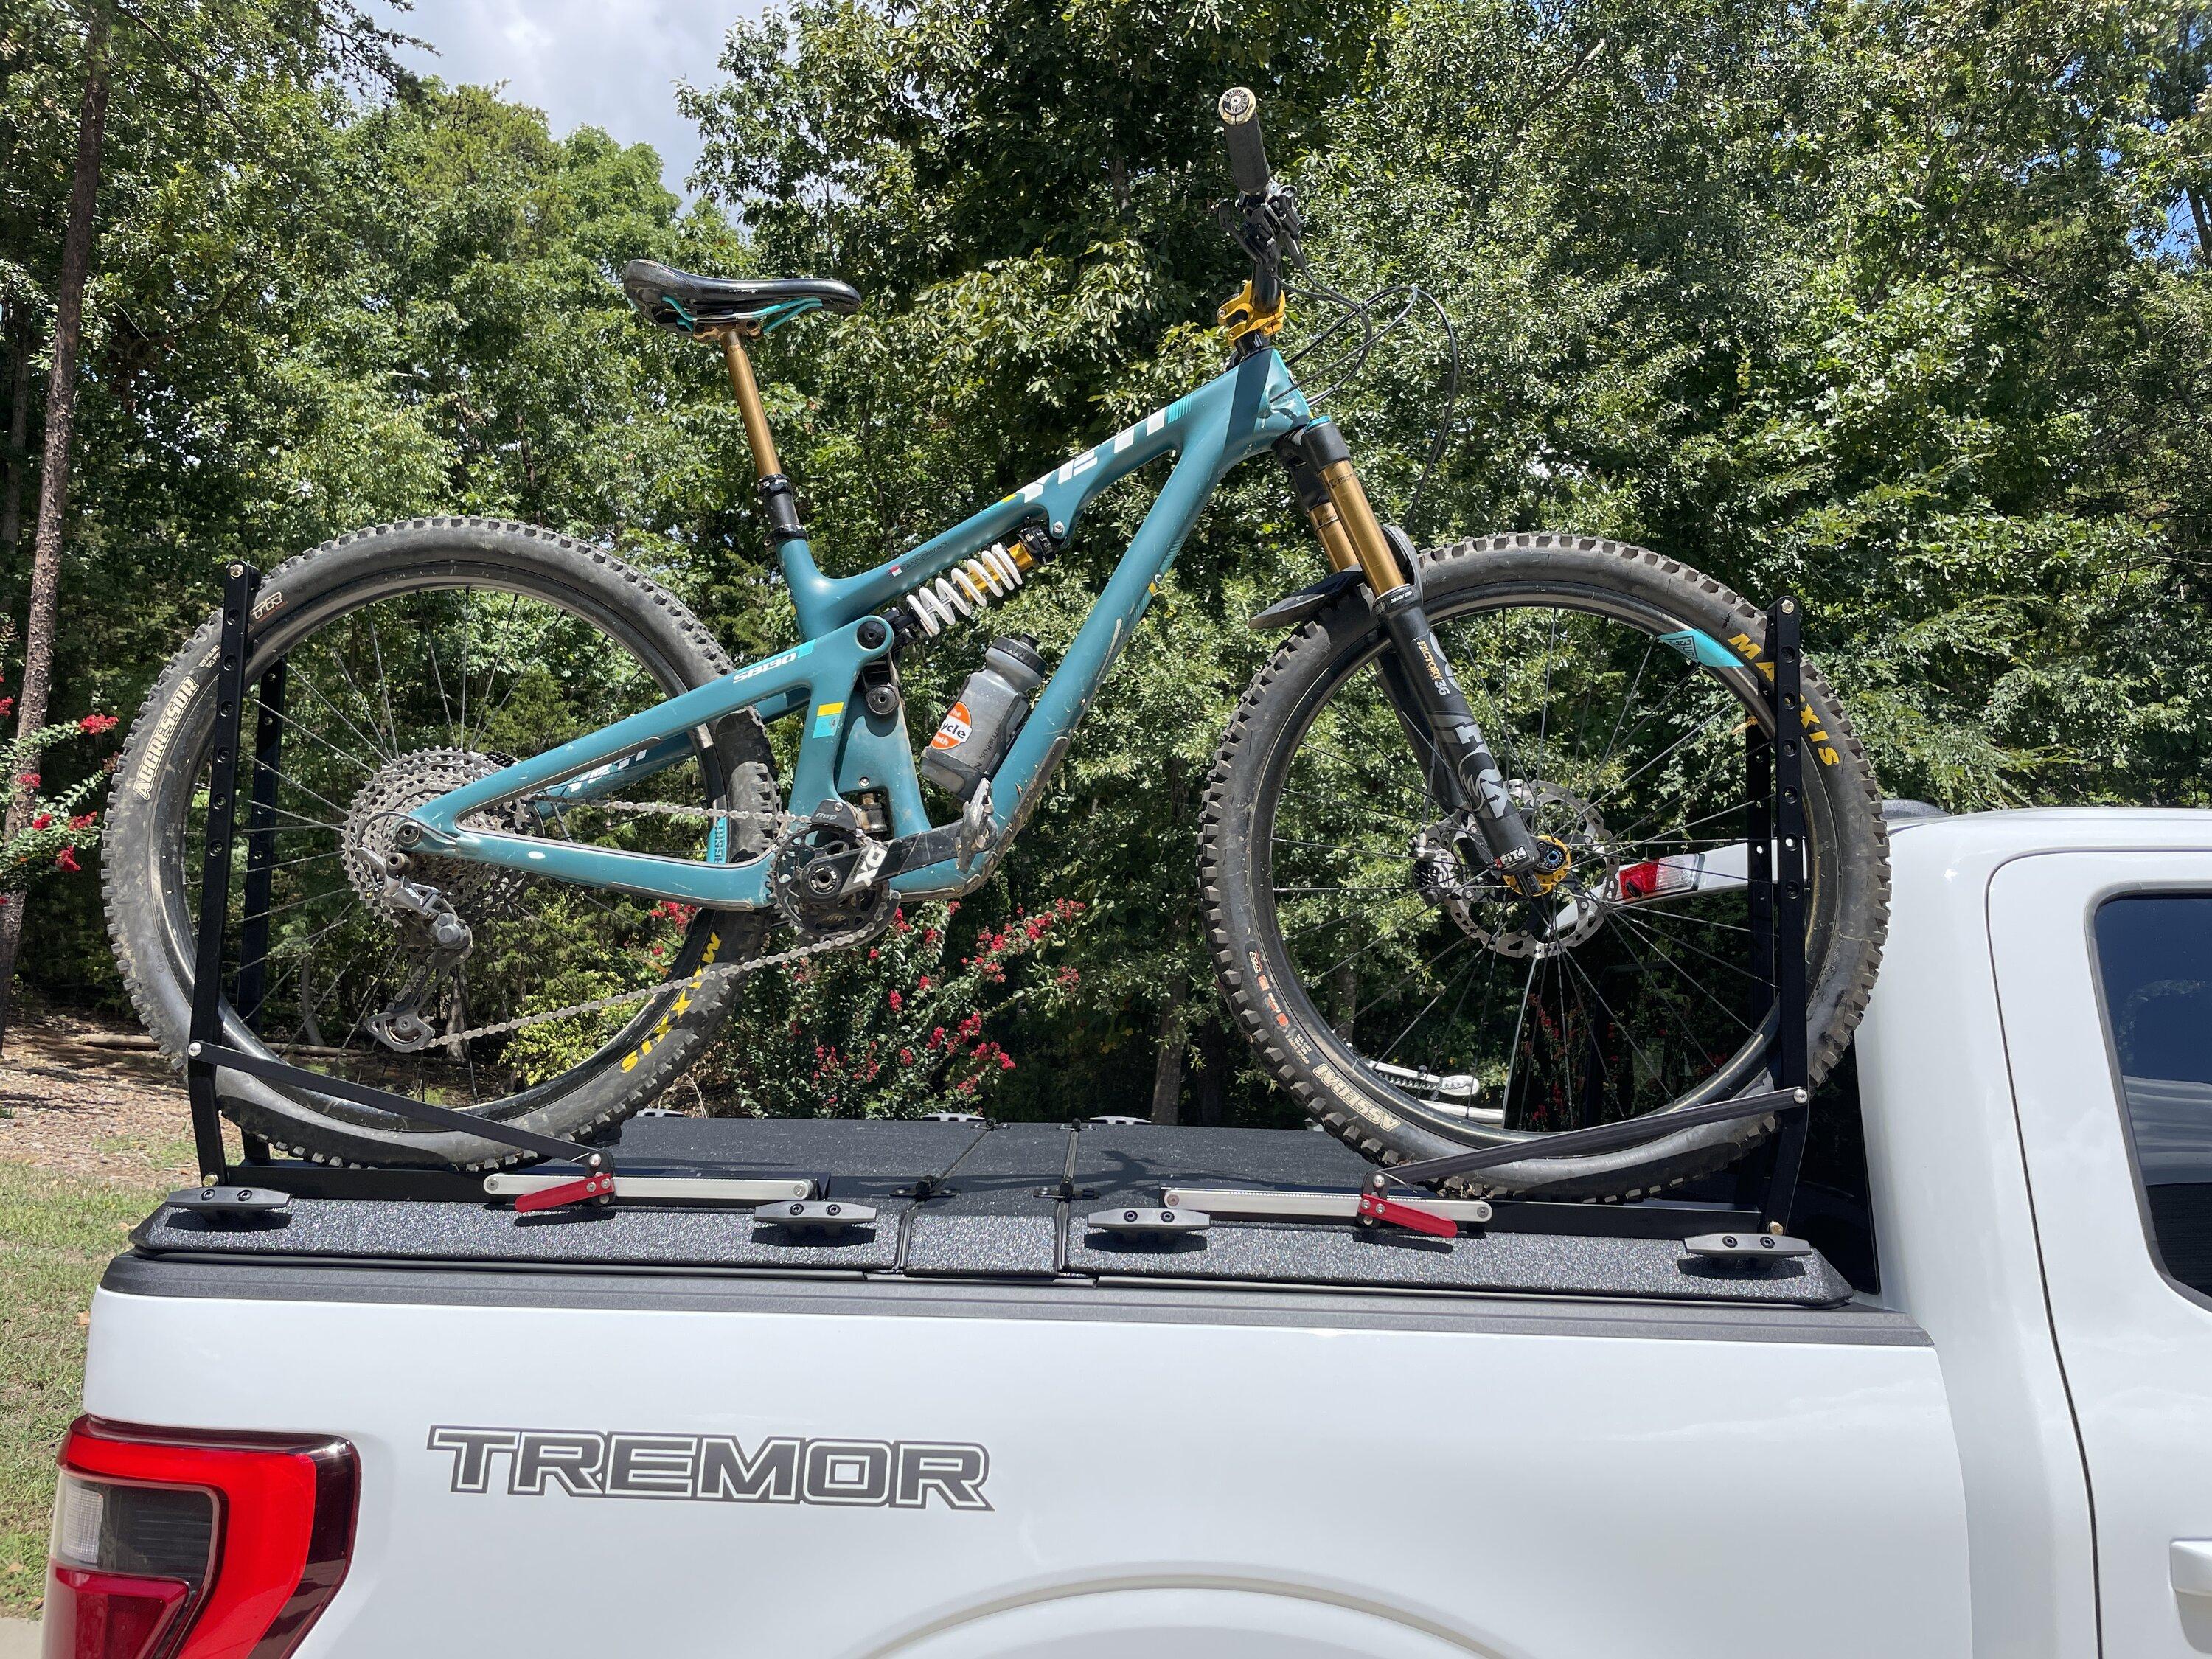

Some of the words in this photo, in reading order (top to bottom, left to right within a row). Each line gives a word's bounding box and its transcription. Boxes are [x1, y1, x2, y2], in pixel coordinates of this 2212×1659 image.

[250, 591, 283, 619] TR
[733, 652, 796, 684] SB130
[1417, 640, 1443, 680] FACTORY
[1434, 679, 1450, 696] 36
[1728, 633, 1840, 765] MAXIS
[133, 676, 200, 800] AGGRESSOR
[1455, 723, 1510, 818] FOX
[815, 813, 838, 821] mrp
[850, 855, 864, 880] SRAM
[621, 931, 721, 1074] MAXXIS
[1312, 1063, 1401, 1132] ASSEGAI
[427, 1424, 995, 1512] TREMOR
